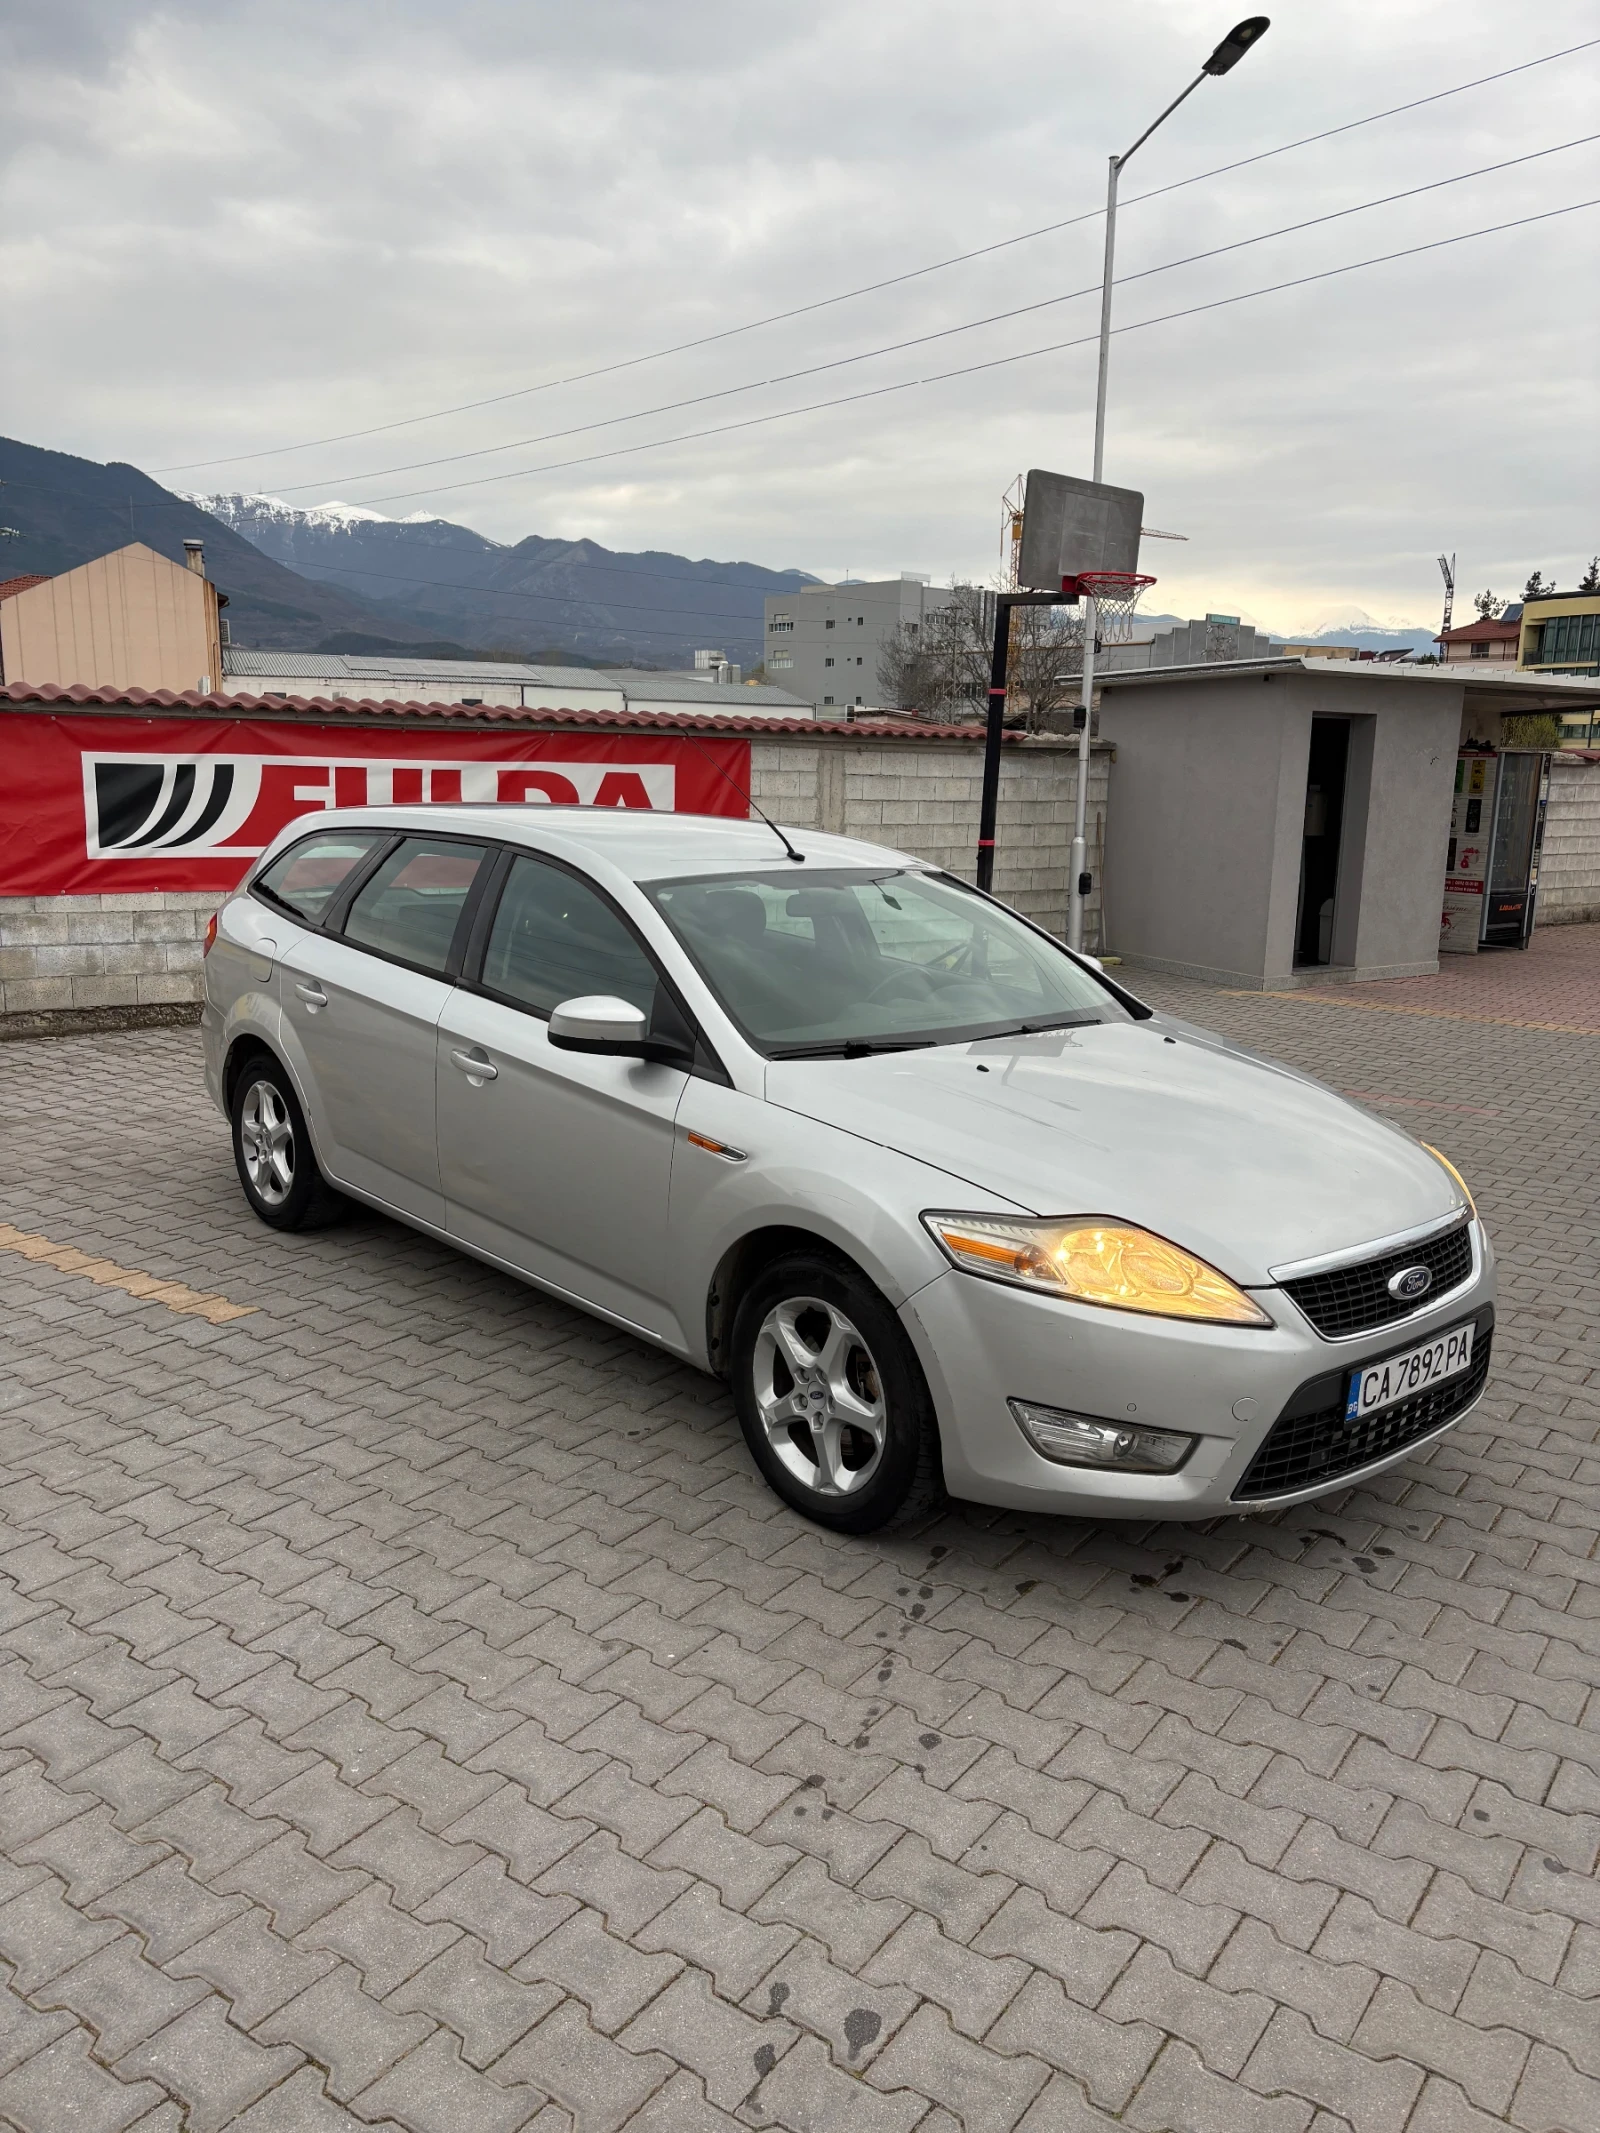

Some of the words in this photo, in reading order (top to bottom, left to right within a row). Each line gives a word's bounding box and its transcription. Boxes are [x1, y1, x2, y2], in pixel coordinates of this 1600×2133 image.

[1406, 1274, 1425, 1292] Ford
[1363, 1366, 1390, 1408] CA
[1394, 1343, 1445, 1396] 7892
[1445, 1331, 1468, 1372] PA
[1347, 1401, 1358, 1414] BG
